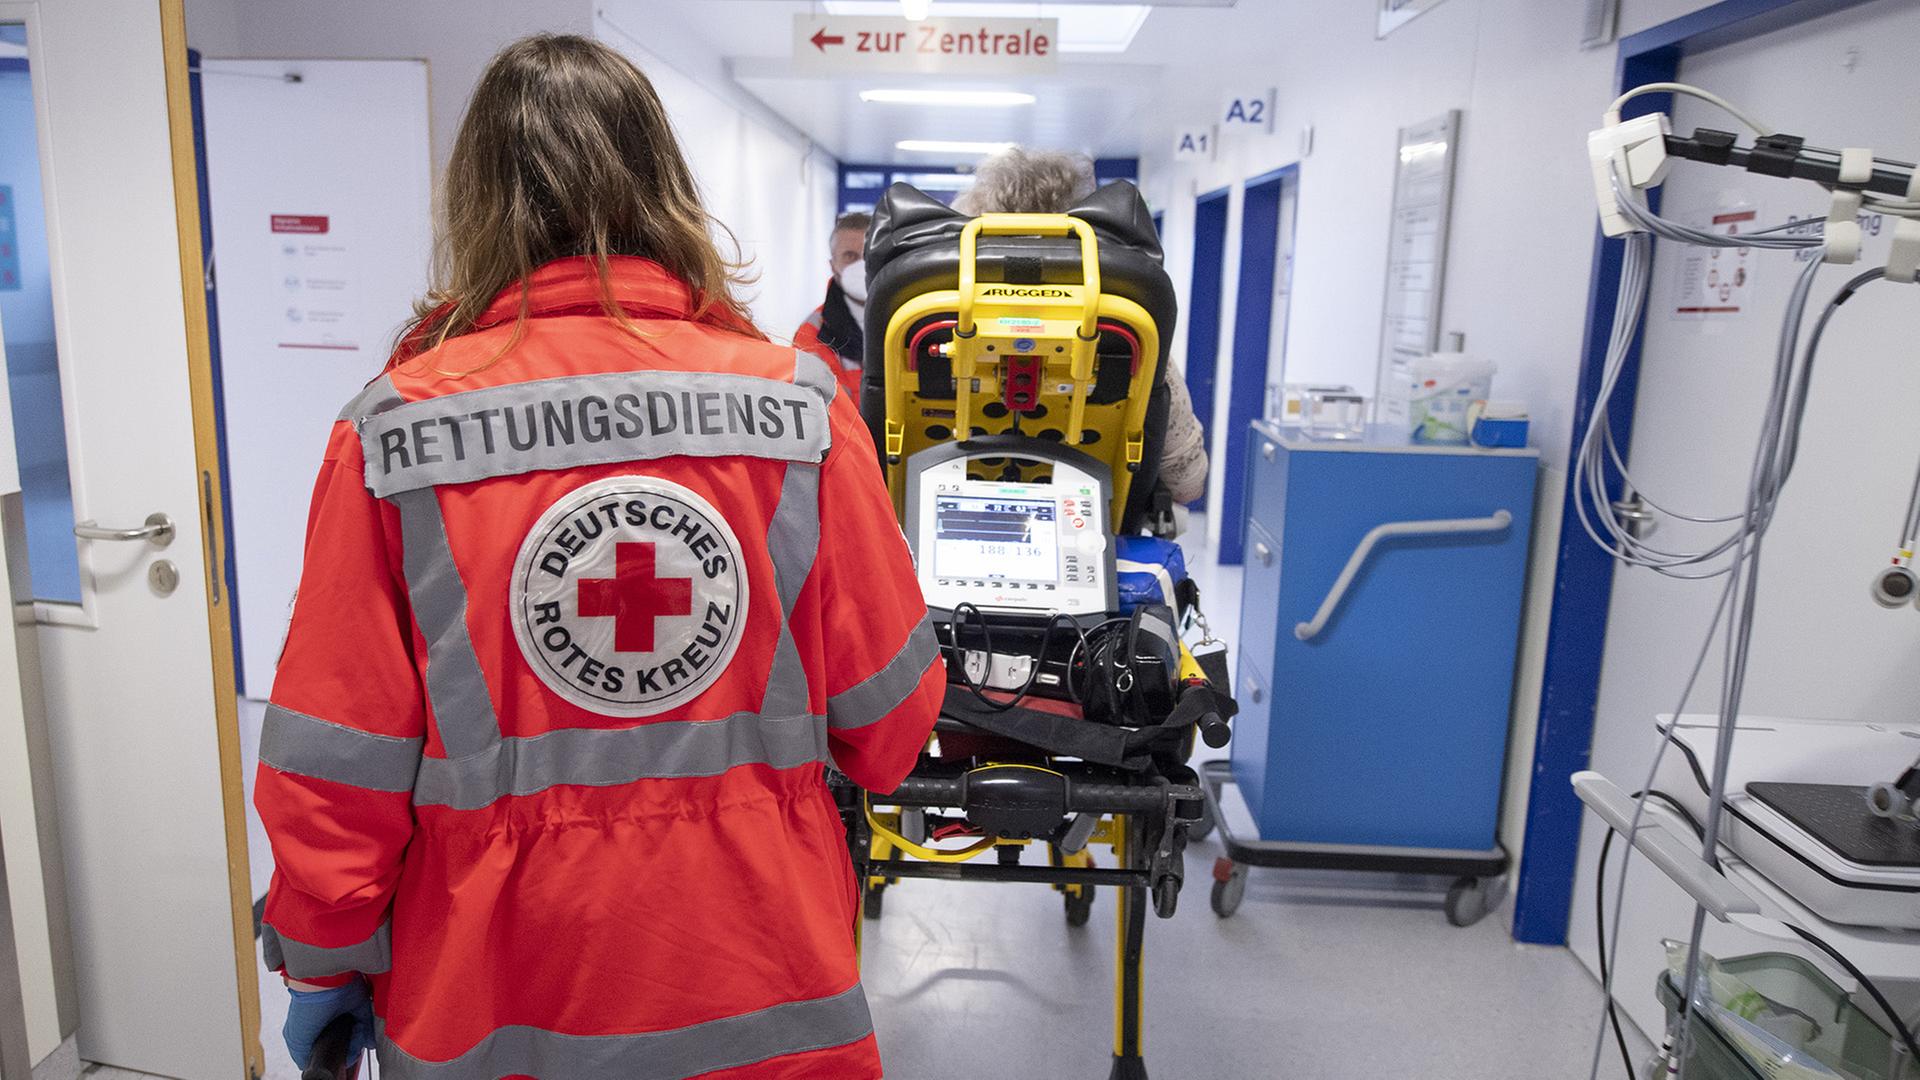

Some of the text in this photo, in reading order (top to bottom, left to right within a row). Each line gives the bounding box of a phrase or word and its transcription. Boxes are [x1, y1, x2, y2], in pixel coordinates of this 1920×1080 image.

[857, 26, 1050, 56] zur Zentrale
[1226, 98, 1265, 123] A2
[1179, 133, 1207, 153] A1
[991, 288, 1063, 298] RUGGED
[379, 390, 808, 476] RETTUNGSDIENST
[539, 499, 728, 580] DEUTSCHES
[533, 600, 731, 695] ROTES KREUZ
